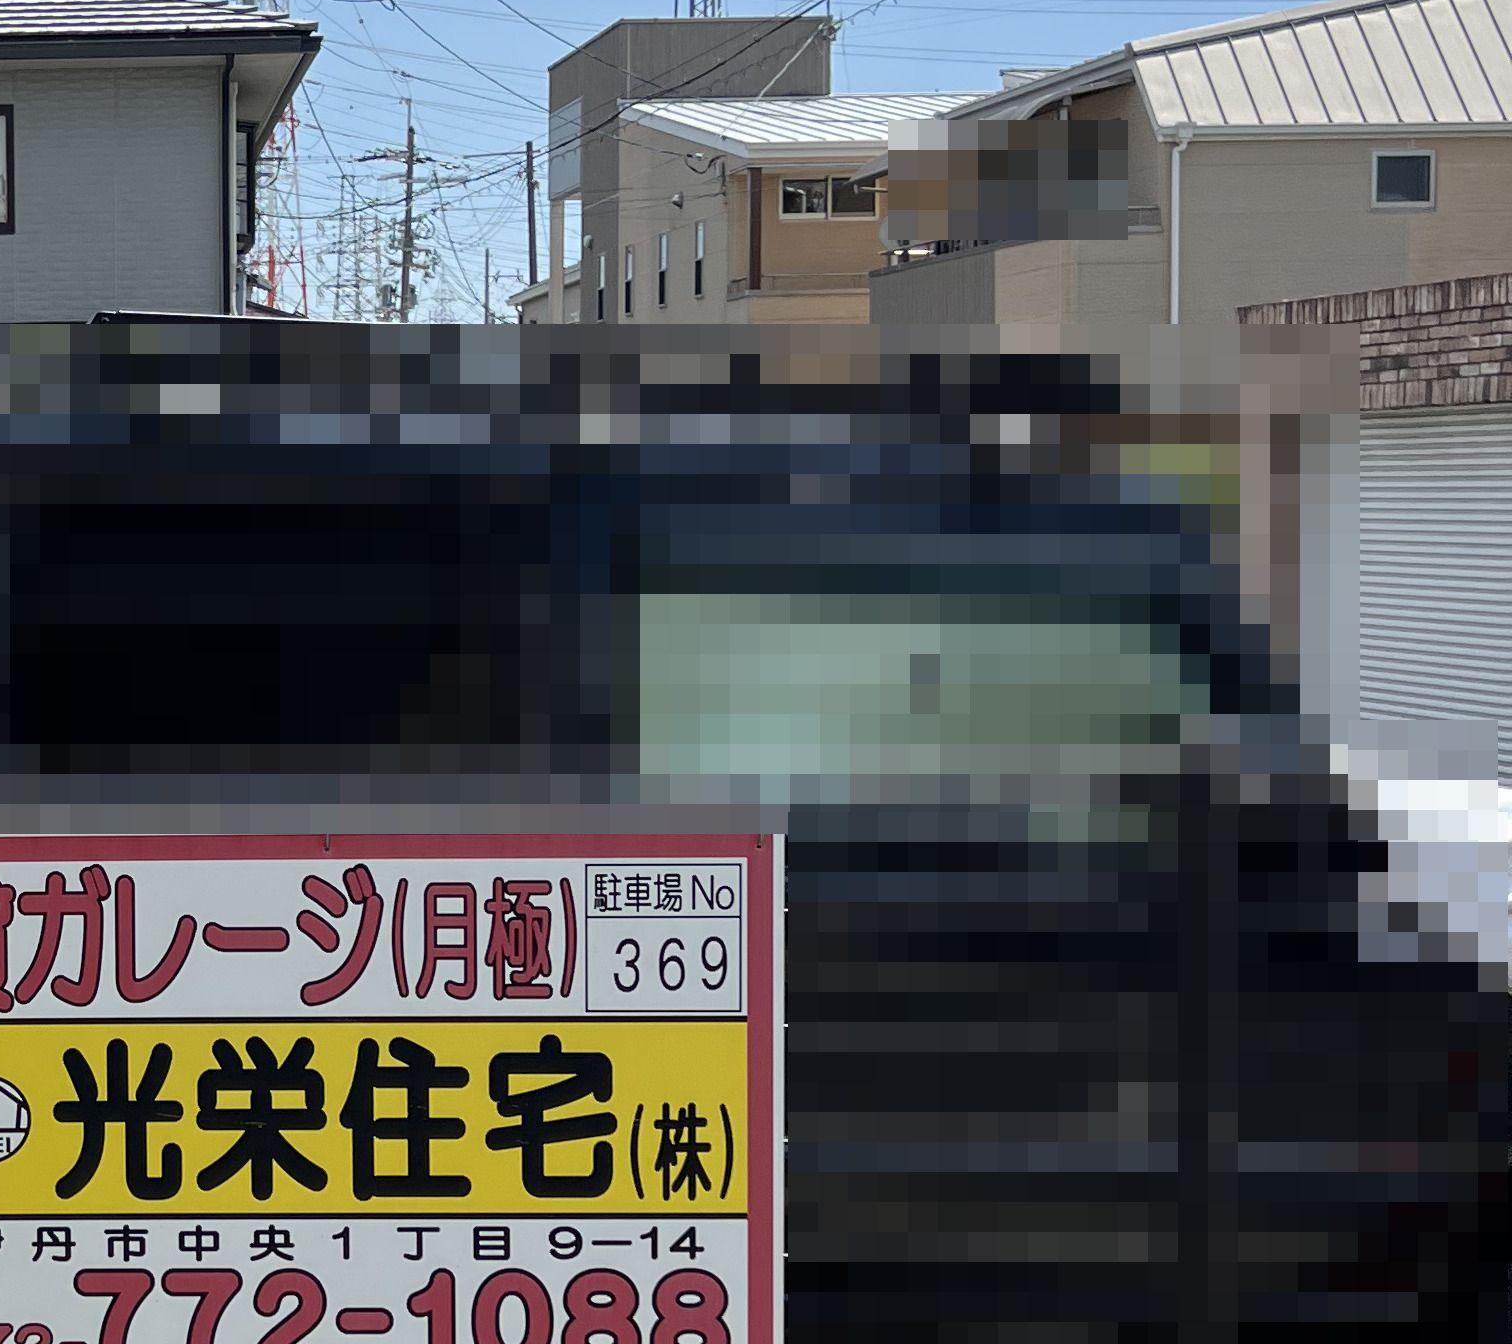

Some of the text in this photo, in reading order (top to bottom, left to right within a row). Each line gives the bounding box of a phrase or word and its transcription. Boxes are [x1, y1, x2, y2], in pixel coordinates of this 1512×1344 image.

[613, 936, 728, 993] 369
[53, 1034, 734, 1201] 光栄住宅(株)
